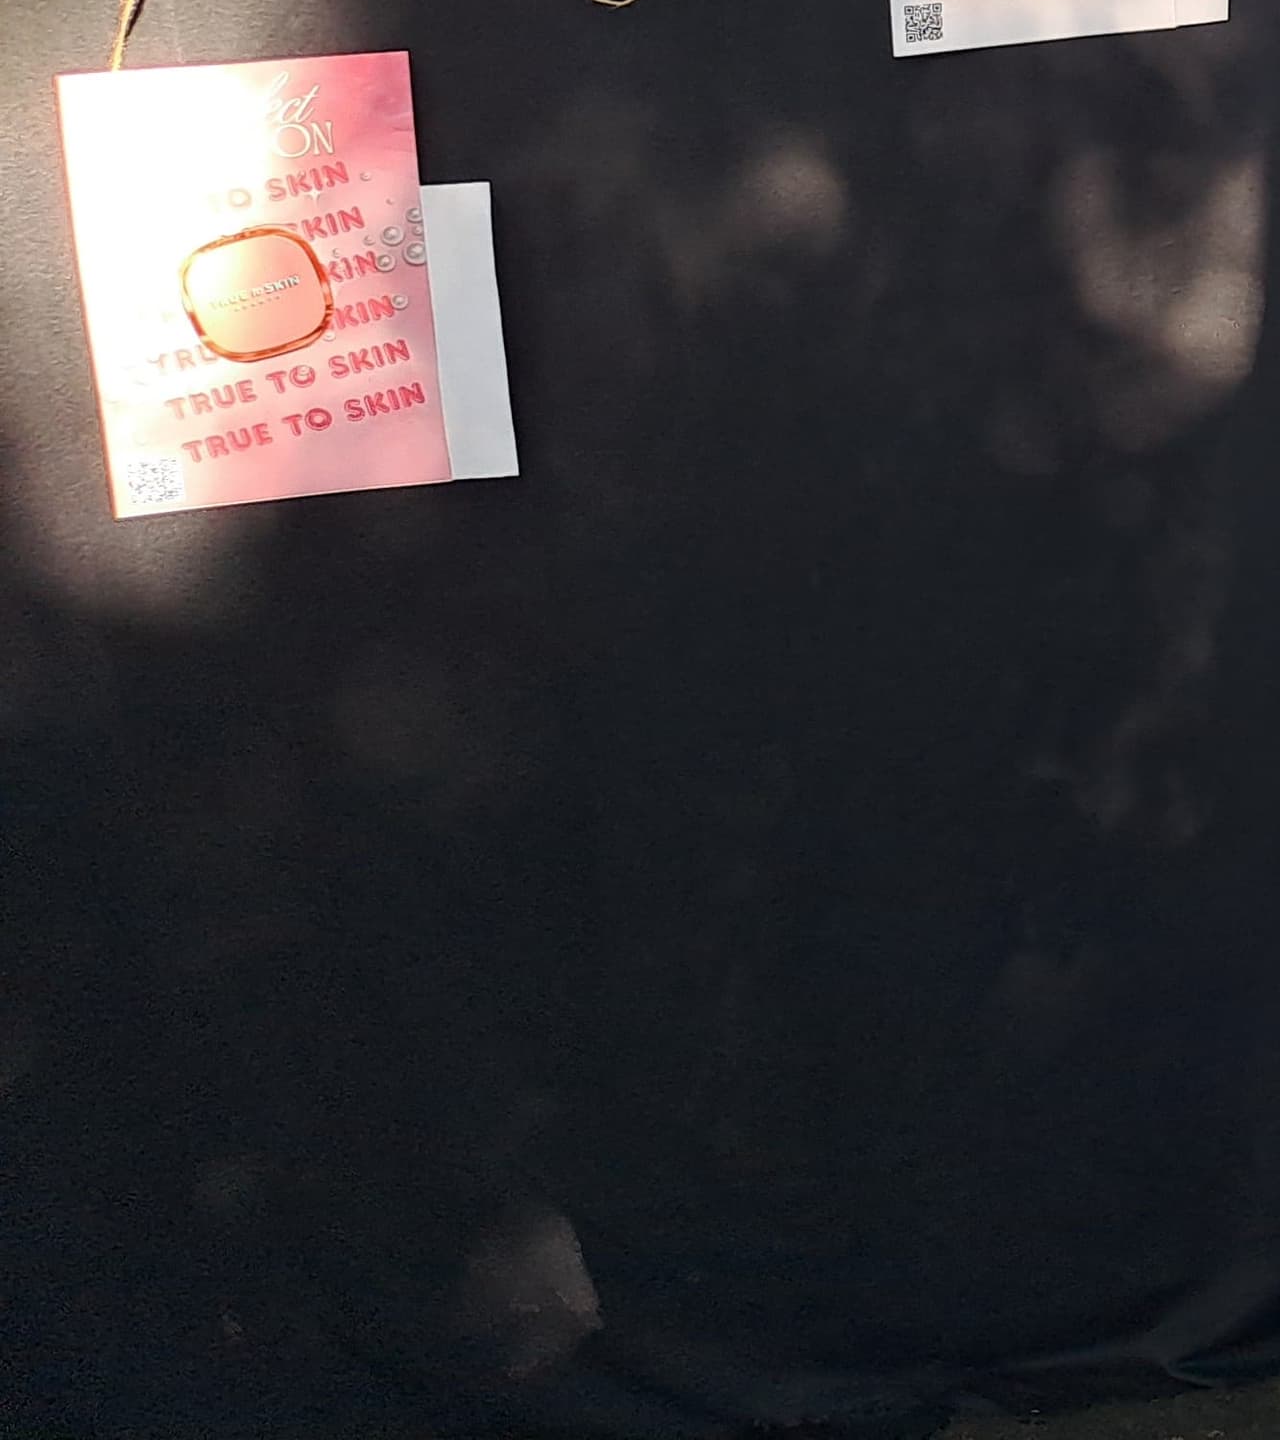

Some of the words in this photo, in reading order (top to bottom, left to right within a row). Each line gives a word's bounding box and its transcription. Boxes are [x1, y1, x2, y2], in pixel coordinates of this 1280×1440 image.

[265, 161, 349, 201] SKIN
[288, 206, 366, 242] KIN
[327, 250, 380, 283] KIN
[327, 295, 396, 331] KIN
[164, 379, 258, 420] TRUE
[266, 364, 316, 394] TO
[328, 339, 411, 379] SKIN
[181, 422, 273, 464] TRUE
[282, 407, 333, 437] TO
[344, 381, 426, 422] SKIN
